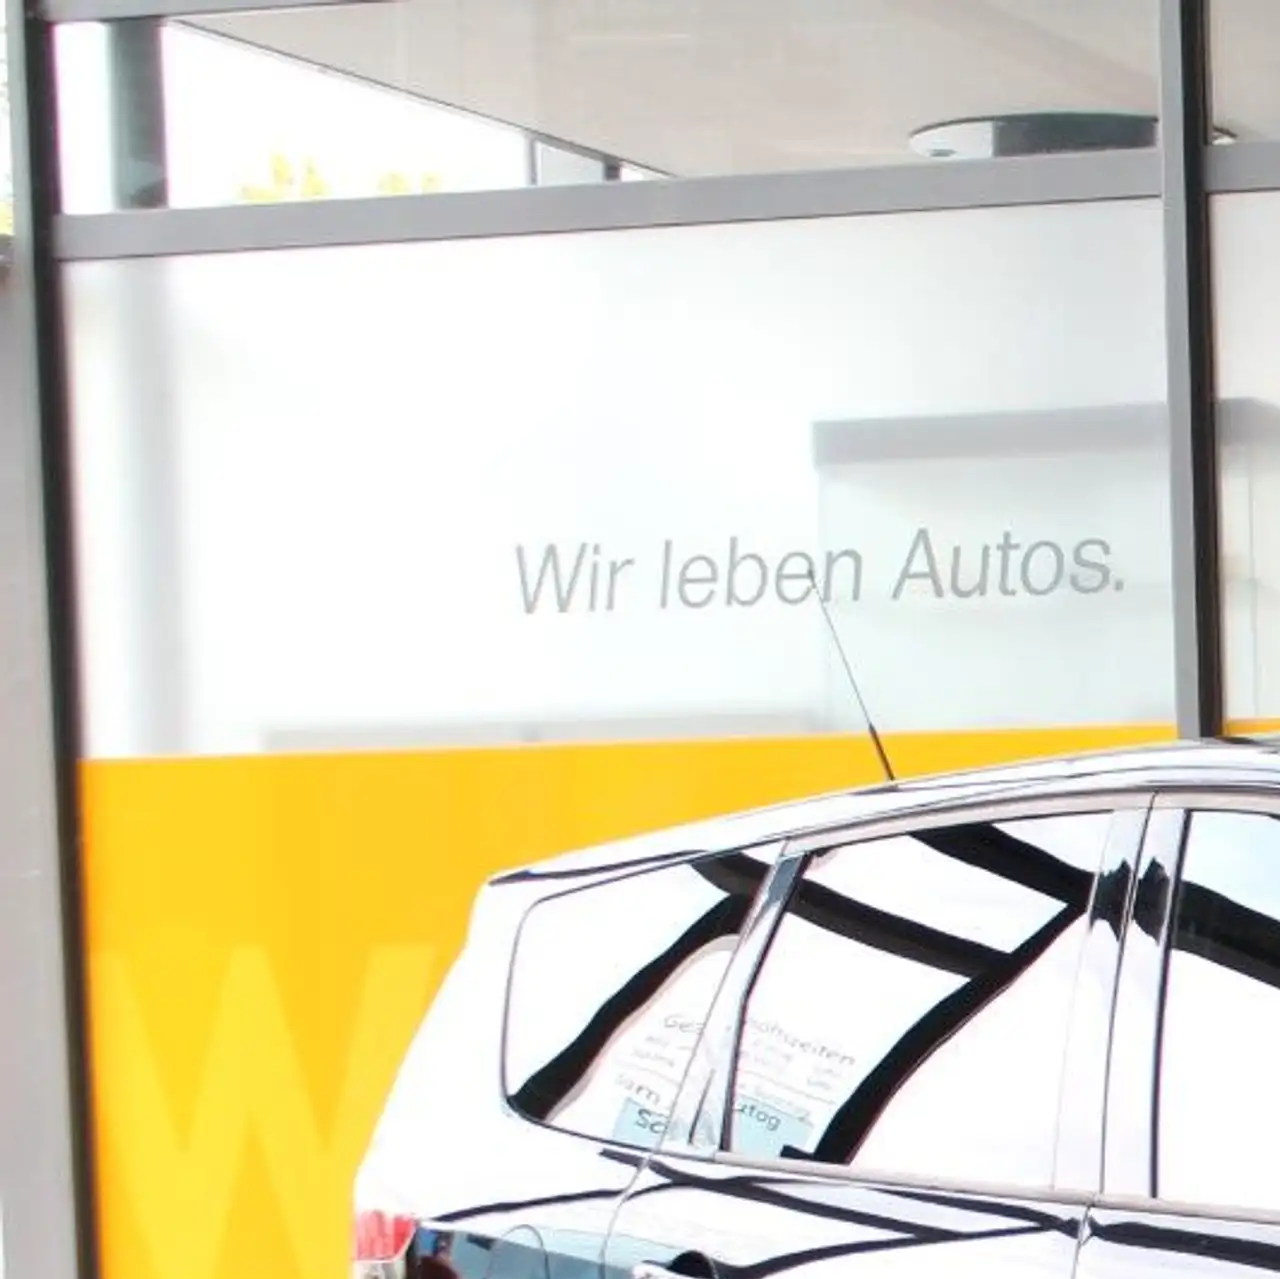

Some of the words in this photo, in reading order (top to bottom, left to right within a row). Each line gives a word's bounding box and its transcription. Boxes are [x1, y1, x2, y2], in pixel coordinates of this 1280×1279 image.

[514, 541, 636, 615] Wir
[658, 535, 864, 611] leben
[890, 525, 1126, 600] Autos.
